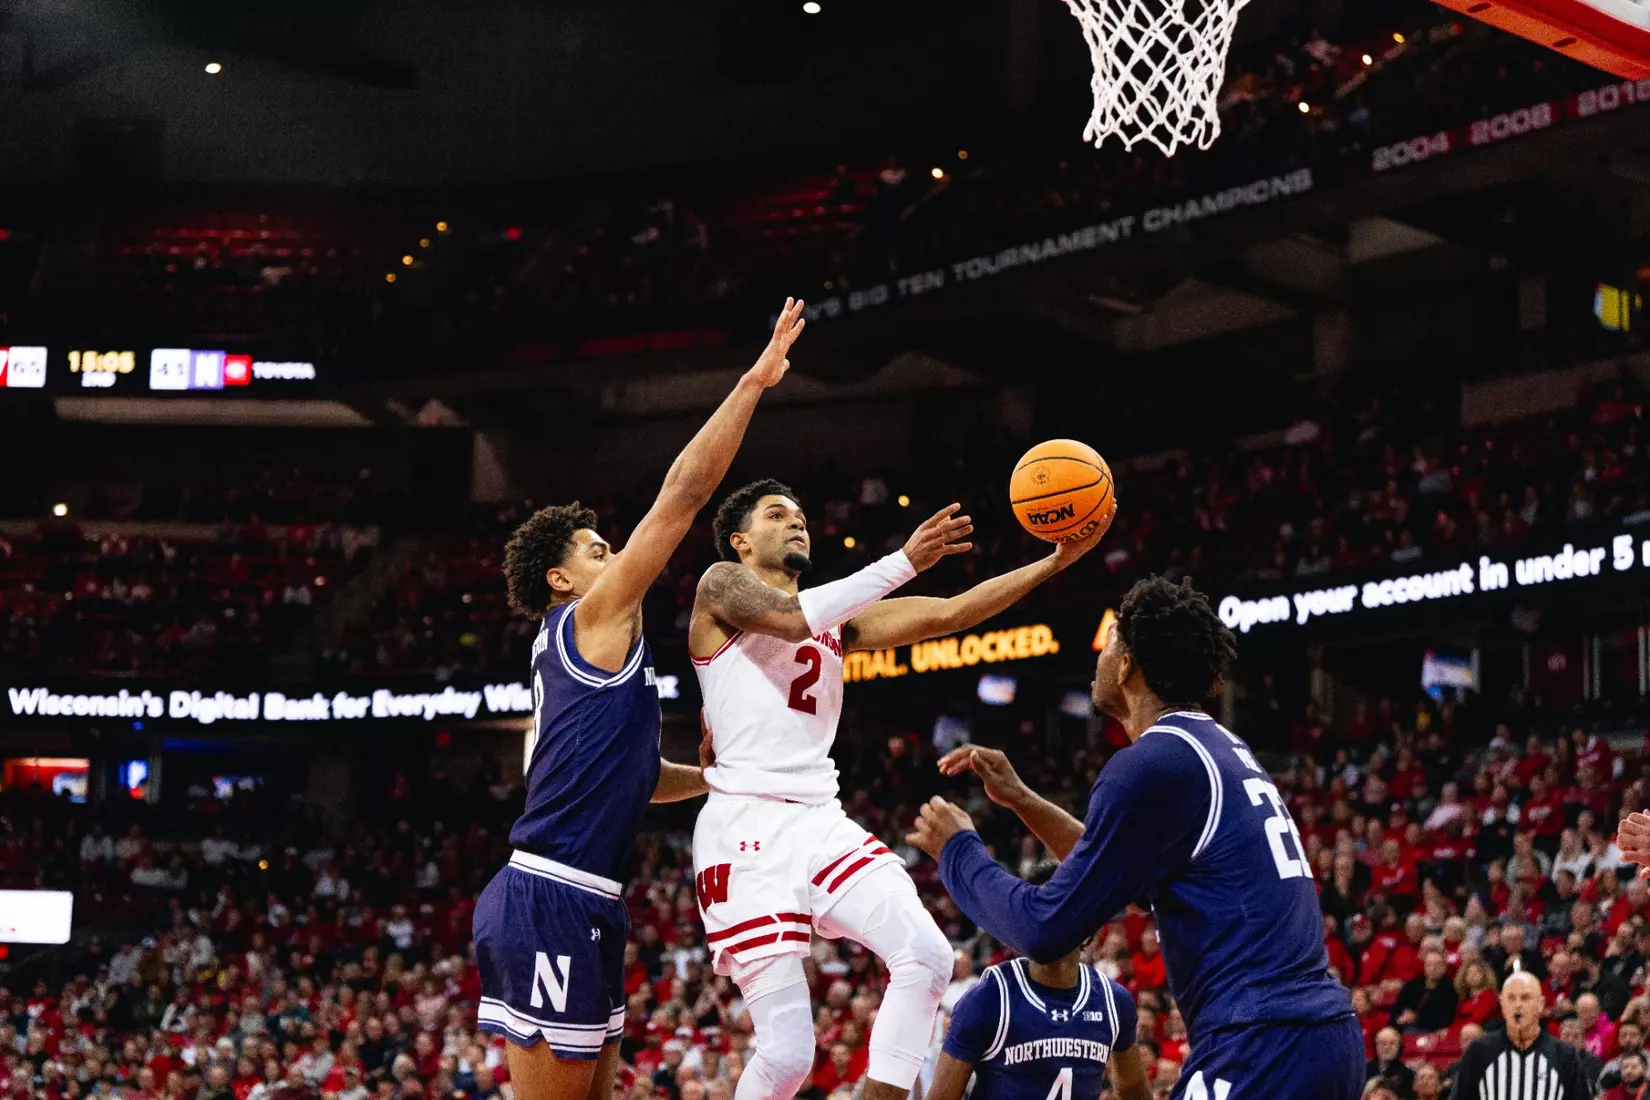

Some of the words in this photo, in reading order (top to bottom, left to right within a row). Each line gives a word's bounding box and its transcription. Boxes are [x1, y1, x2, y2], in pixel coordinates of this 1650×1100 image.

[1372, 131, 1449, 171] 2004
[1471, 102, 1552, 144] 2008
[848, 284, 889, 311] BIG
[897, 268, 945, 296] TEN
[953, 215, 1135, 280] TOURNAMENT
[1142, 167, 1314, 232] CHAMPIONS
[253, 362, 316, 379] TOYOTA
[1027, 503, 1075, 525] NCAA
[1218, 595, 1290, 632] Open
[1294, 585, 1357, 624] your
[1362, 563, 1474, 607] account
[1479, 556, 1508, 591] in
[1515, 544, 1605, 585] under
[1613, 534, 1634, 570] 5
[911, 624, 1060, 673] UNLOCKED.
[9, 687, 164, 717] Wisconsin's
[169, 690, 260, 724] Digital
[264, 693, 329, 720] Bank
[332, 691, 370, 719] for
[372, 686, 481, 720] Everyday
[788, 646, 822, 716] 2
[697, 863, 732, 913] W
[530, 951, 571, 1013] N
[1004, 1037, 1110, 1066] NORTHWESTERN
